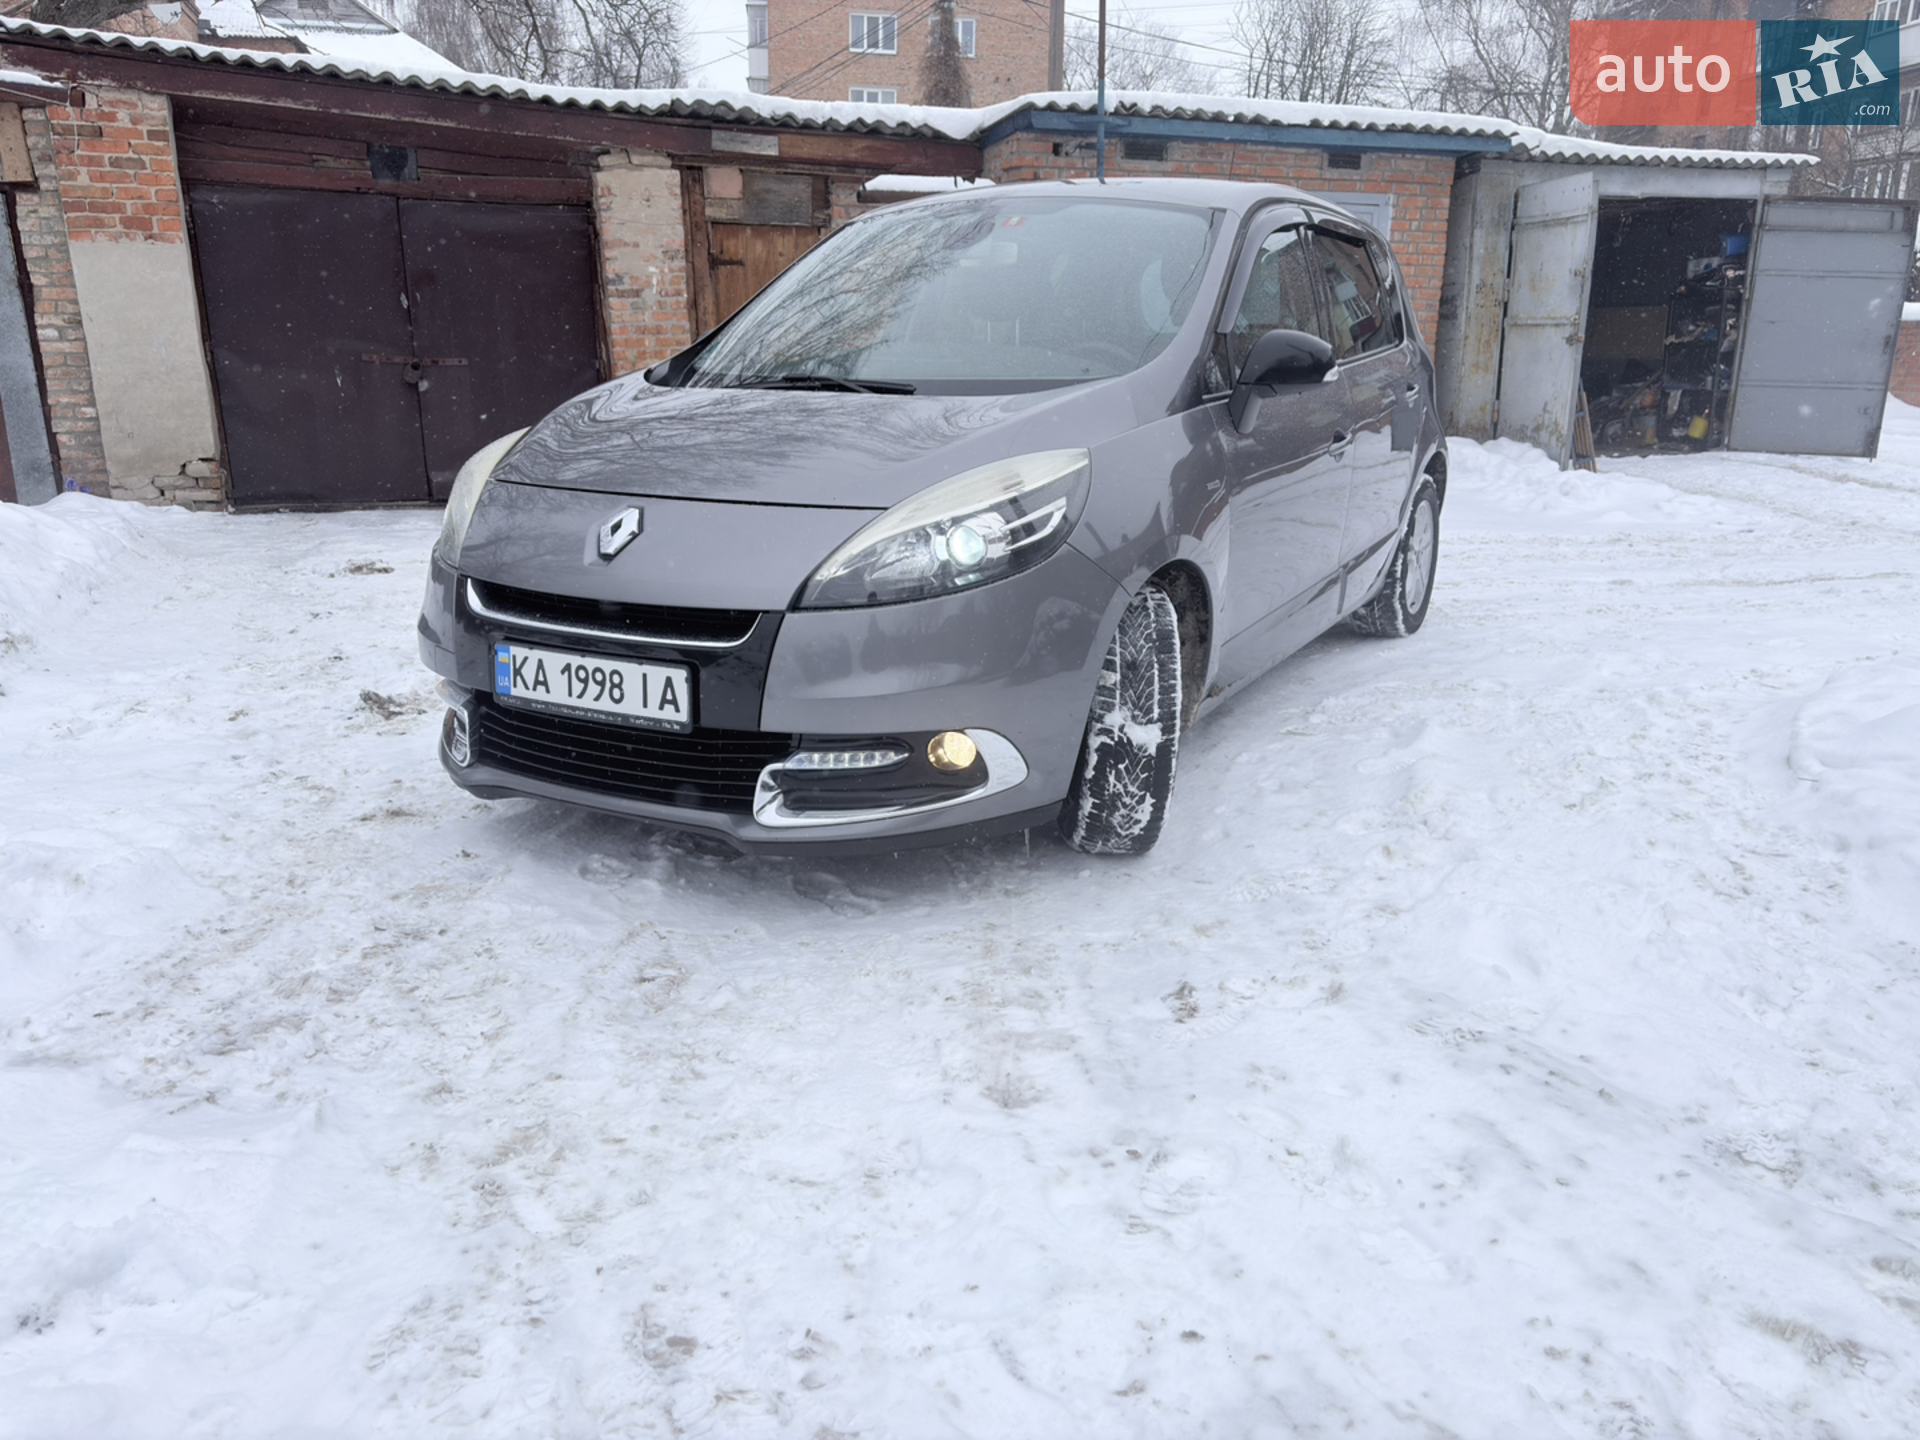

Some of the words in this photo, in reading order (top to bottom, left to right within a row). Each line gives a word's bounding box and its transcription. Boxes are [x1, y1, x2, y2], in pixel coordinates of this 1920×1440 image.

[498, 675, 510, 687] UA
[512, 654, 550, 694] KA
[560, 662, 625, 704] 1998
[642, 672, 681, 713] IA
